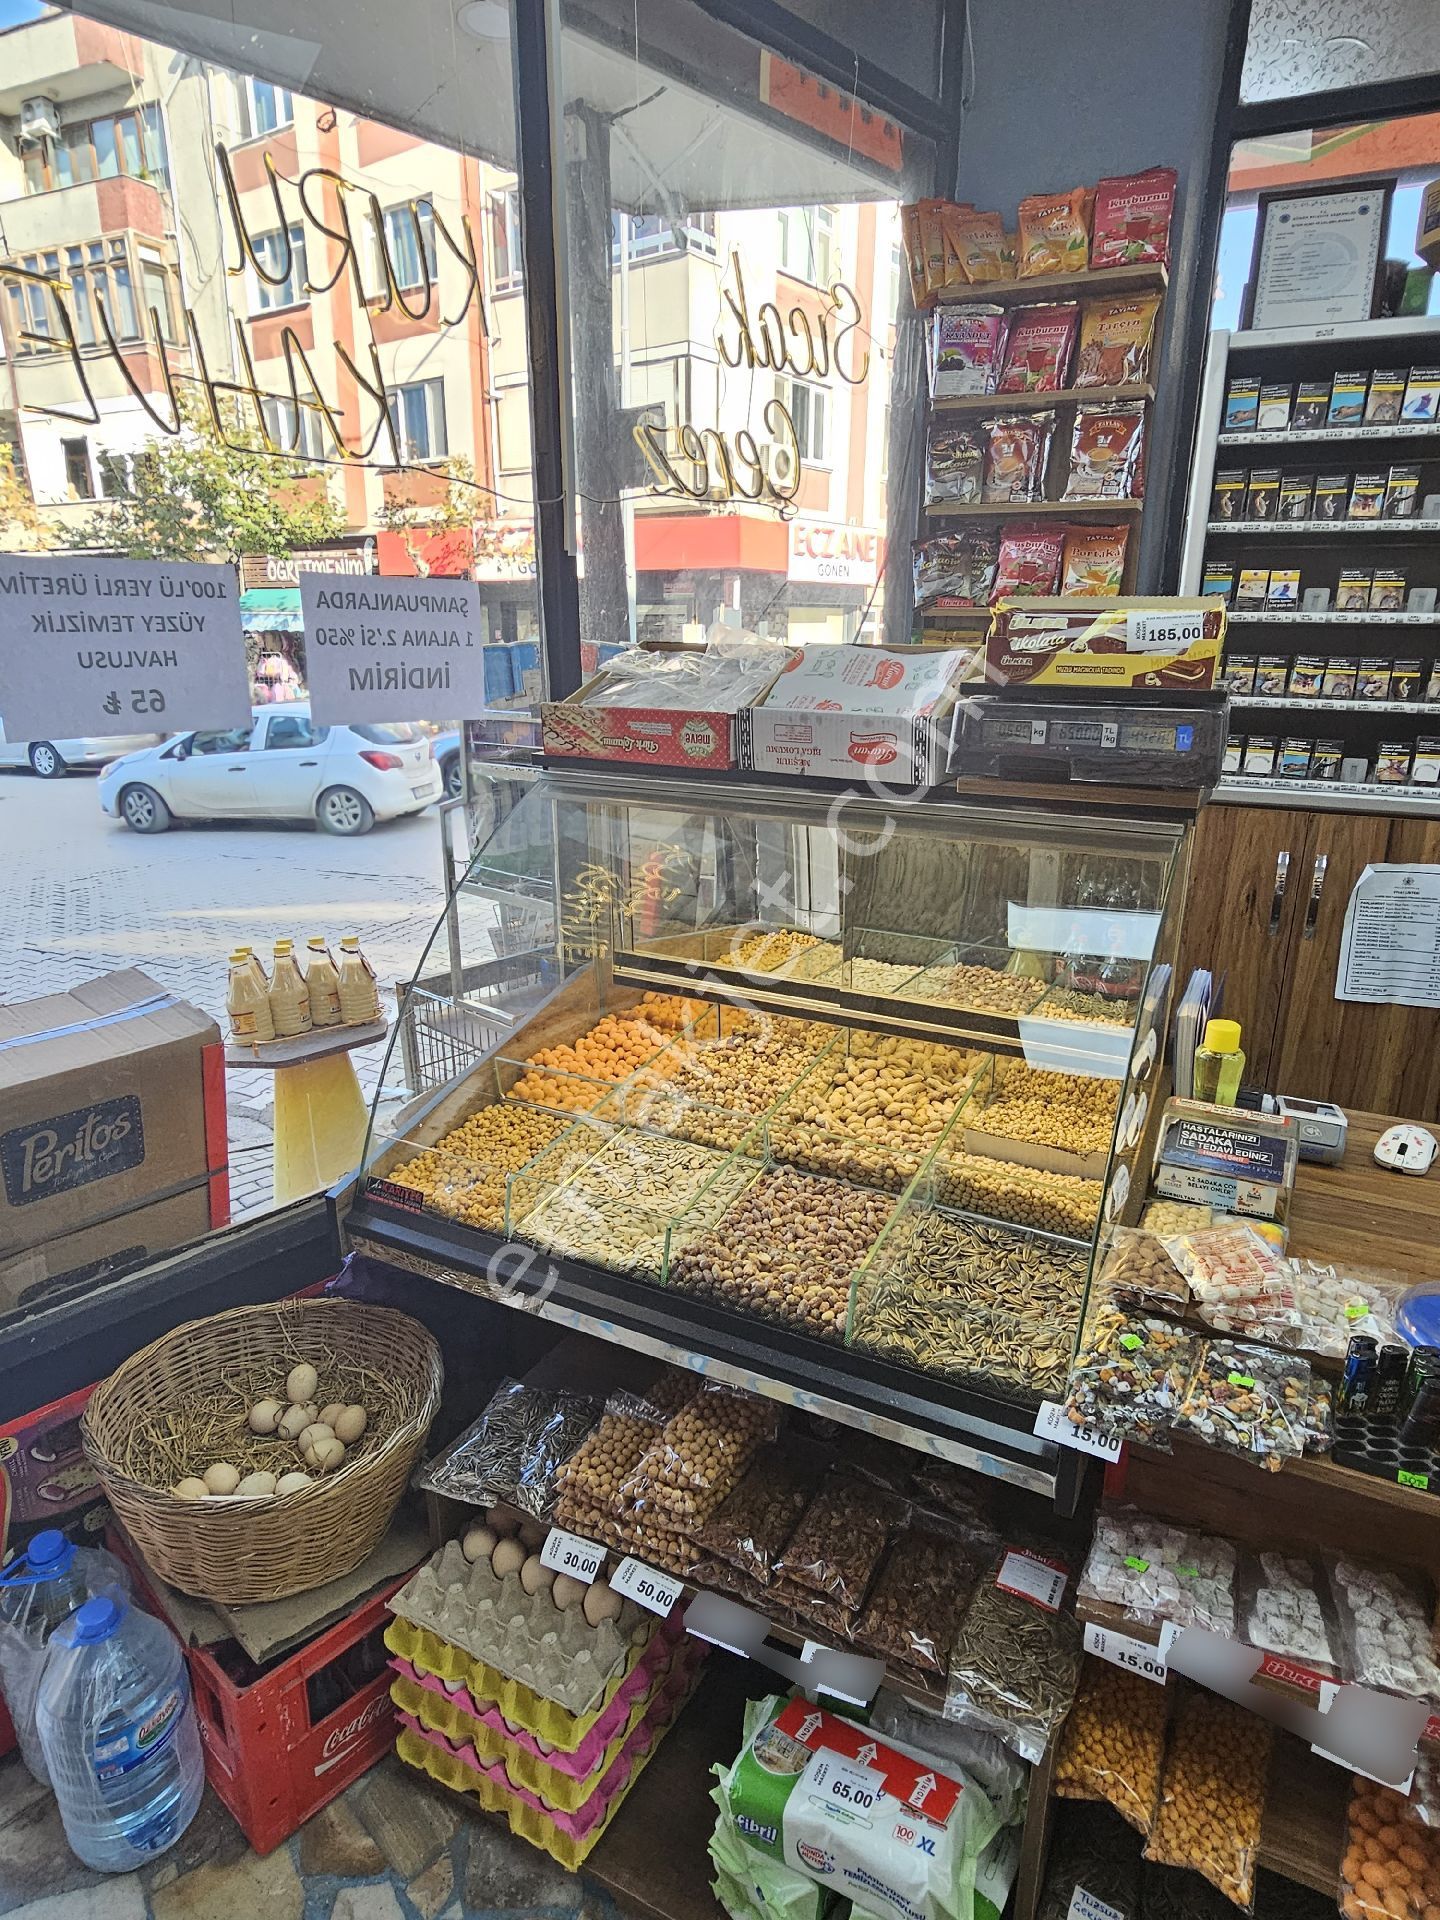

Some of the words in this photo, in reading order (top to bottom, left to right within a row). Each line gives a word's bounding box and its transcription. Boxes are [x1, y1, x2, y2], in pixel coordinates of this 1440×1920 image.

[1108, 192, 1169, 209] Kuşburnu
[1016, 325, 1069, 337] Kuşburnu
[793, 527, 876, 563] ECZANE
[1009, 614, 1068, 630] ÜLKER
[1148, 627, 1202, 642] 185,00
[1000, 655, 1033, 665] ÜLKER
[1033, 727, 1044, 738] kg
[1178, 733, 1190, 744] TL
[766, 744, 805, 756] LOKUMU
[1181, 1130, 1233, 1148] SADAKA
[1182, 1123, 1258, 1143] HASTALARINIZI
[1198, 1141, 1234, 1154] TEDAVİ
[1197, 1178, 1222, 1188] SADAKA
[1071, 1426, 1120, 1452] 15,00
[563, 1551, 597, 1574] 30,00
[625, 1564, 639, 1584] MARKET
[636, 1579, 673, 1608] 50,00
[799, 1713, 822, 1740] İNDİRİM
[858, 1745, 874, 1766] DİRİM
[832, 1781, 873, 1809] 65,00
[912, 1776, 933, 1806] İNDİRİM
[896, 1825, 915, 1841] 100
[916, 1835, 937, 1857] XL
